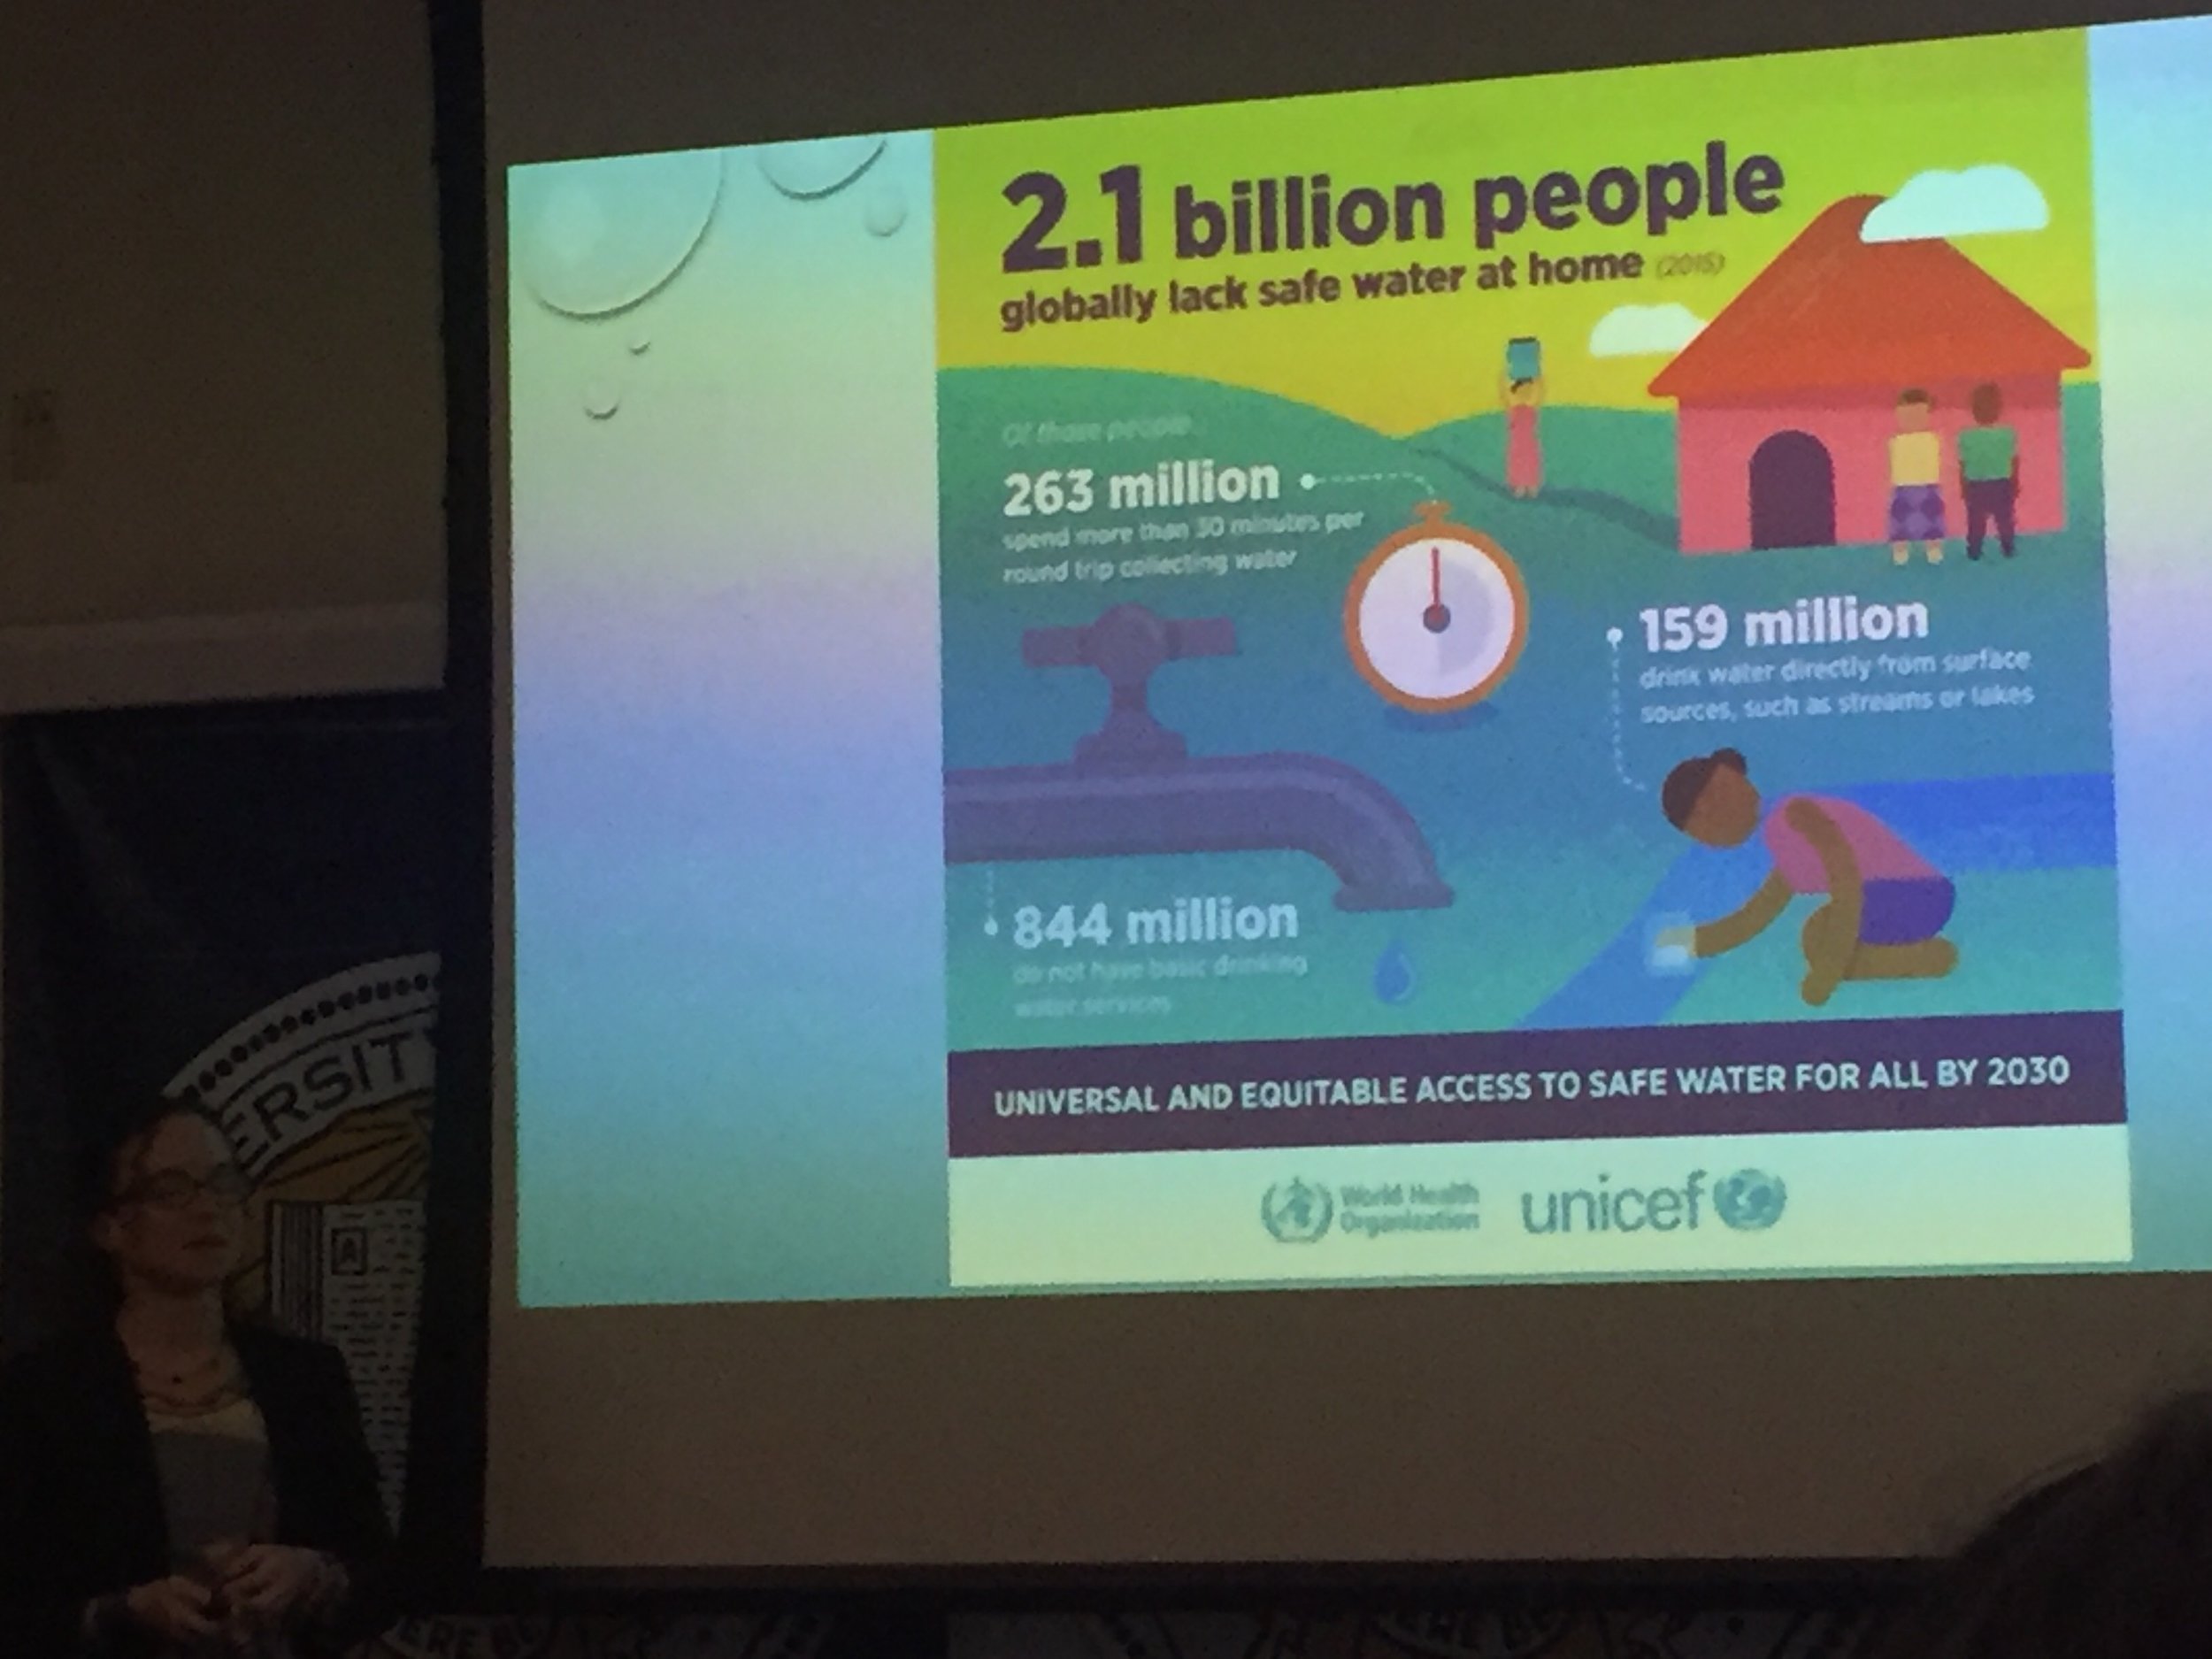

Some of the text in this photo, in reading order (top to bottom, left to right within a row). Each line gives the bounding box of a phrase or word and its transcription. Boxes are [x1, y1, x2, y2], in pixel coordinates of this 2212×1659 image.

[1002, 140, 1786, 273] 2.1 billion people
[1000, 280, 1156, 334] globally
[1170, 275, 1247, 316] lack
[1258, 268, 1340, 308] safe
[1352, 261, 1465, 301] water
[1478, 255, 1517, 290] at
[1529, 246, 1643, 286] home
[1002, 458, 1280, 517] 263 million
[1002, 511, 1364, 552] spend more than 30 minutes per
[1002, 549, 1298, 585] round trip collecting water
[1639, 595, 1930, 654] 159 million
[1639, 647, 2031, 690] drink water directly from surface
[1640, 683, 2036, 725] sources, such as streams or lakes
[1013, 895, 1299, 949] 844 million
[221, 1027, 437, 1172] ERSIT
[995, 1055, 2070, 1118] UNIVERSAL AND EQUITABLE ACCESS TO SAFE WATER FOR ALL BY 2030
[1340, 1182, 1480, 1207] World Health
[1520, 1168, 1709, 1235] unicef
